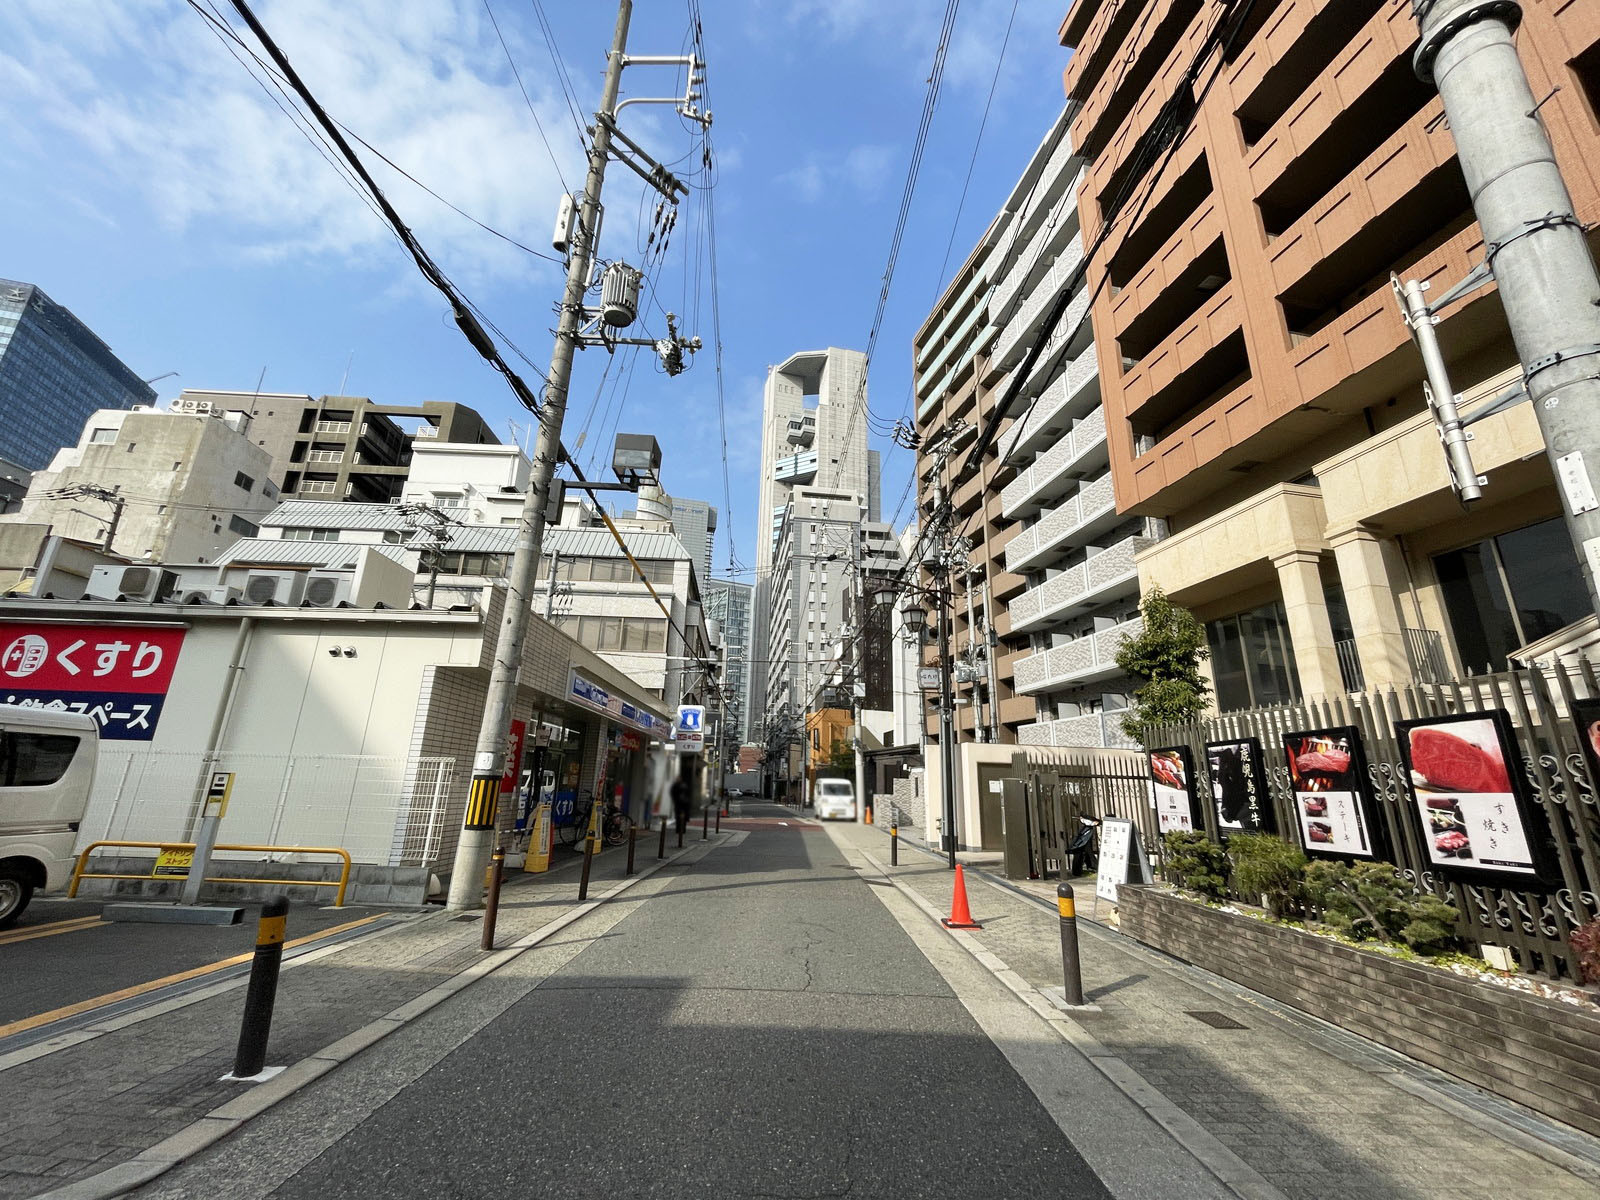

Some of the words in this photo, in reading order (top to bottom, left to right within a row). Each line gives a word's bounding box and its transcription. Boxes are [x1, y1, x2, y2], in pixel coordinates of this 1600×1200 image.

[56, 639, 163, 678] くすり
[555, 799, 574, 816] くすり
[1337, 800, 1351, 843] ステーキ
[1493, 802, 1509, 834] すき
[1482, 818, 1498, 850] 焼き
[160, 848, 193, 857] アイドリン
